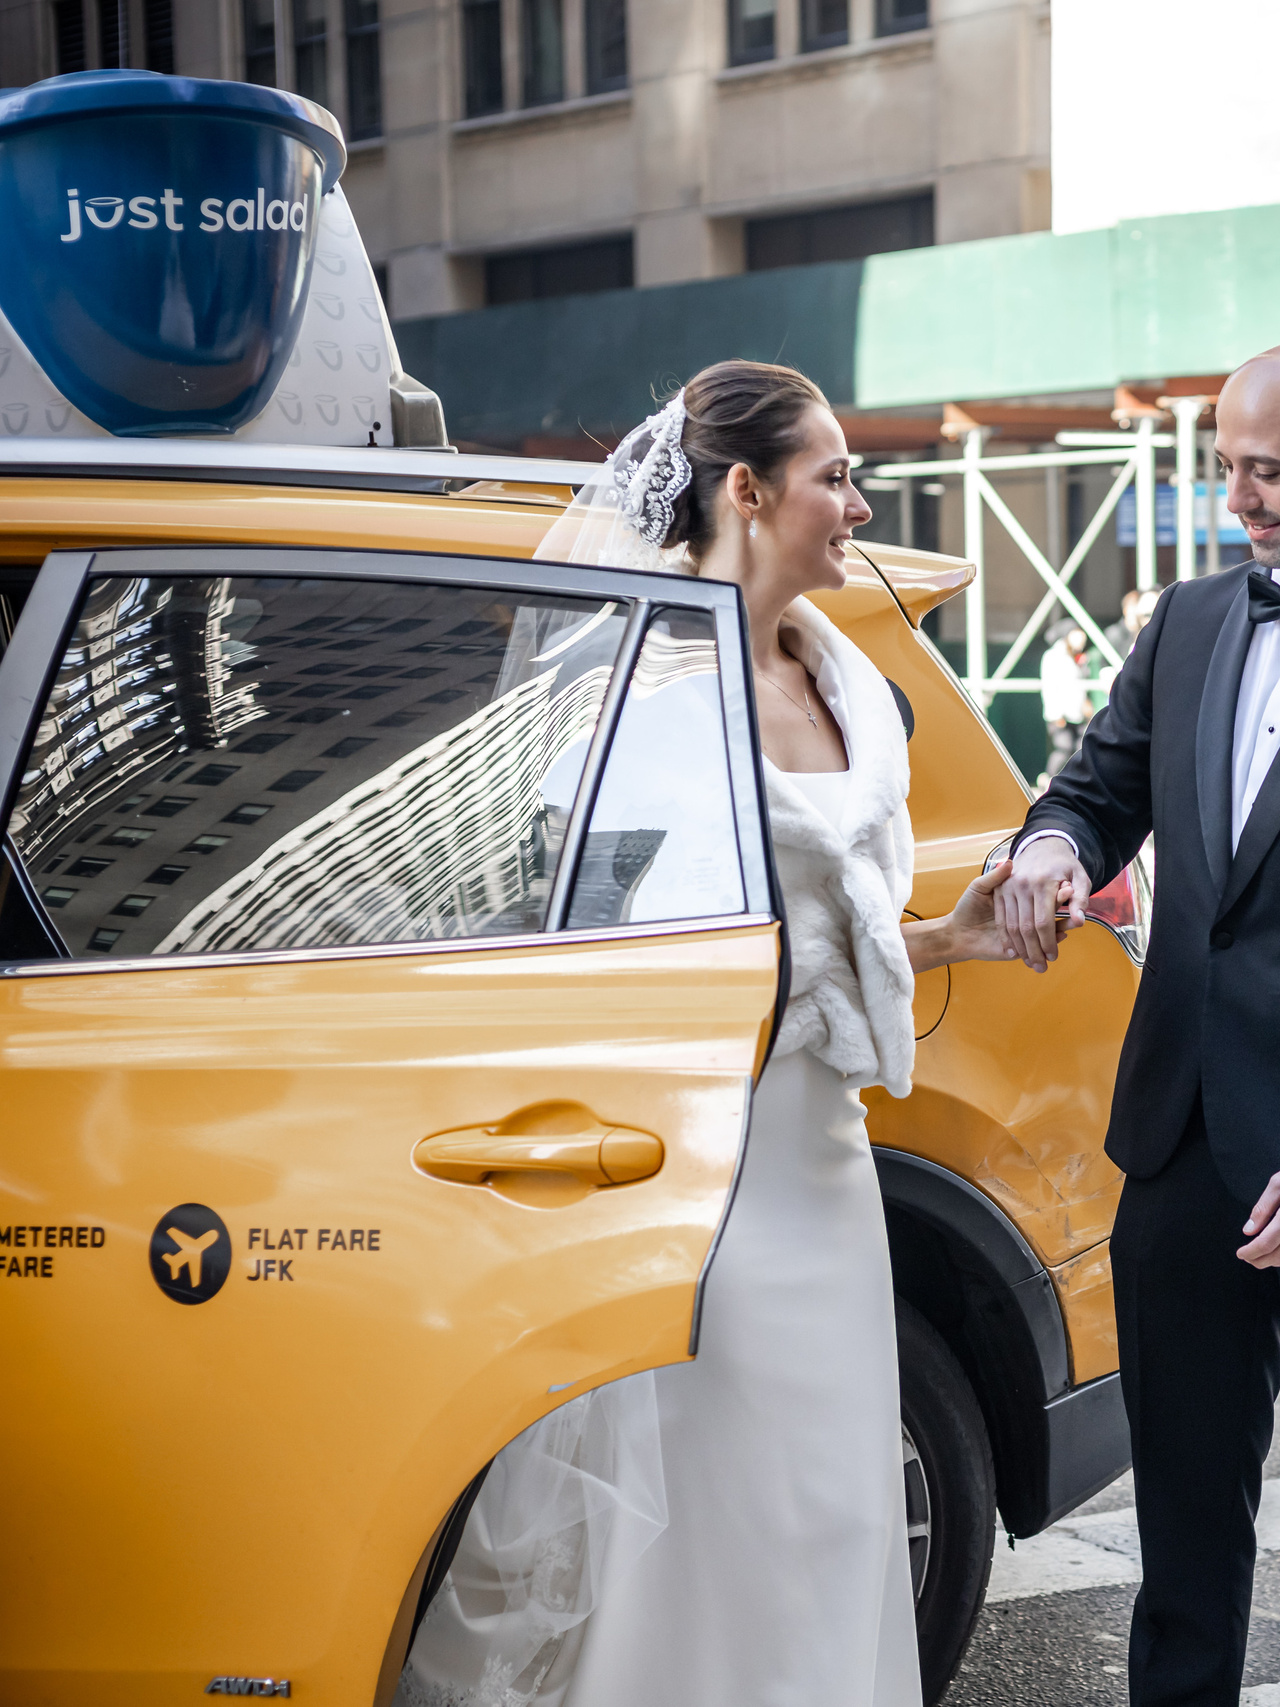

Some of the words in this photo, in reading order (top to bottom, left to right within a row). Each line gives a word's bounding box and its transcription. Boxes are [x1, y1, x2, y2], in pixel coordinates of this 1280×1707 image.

[60, 188, 184, 242] just
[199, 187, 308, 232] salad
[0, 1226, 105, 1248] METERED
[248, 1228, 308, 1250] FLAT
[317, 1229, 381, 1251] FARE
[246, 1259, 294, 1281] JFK
